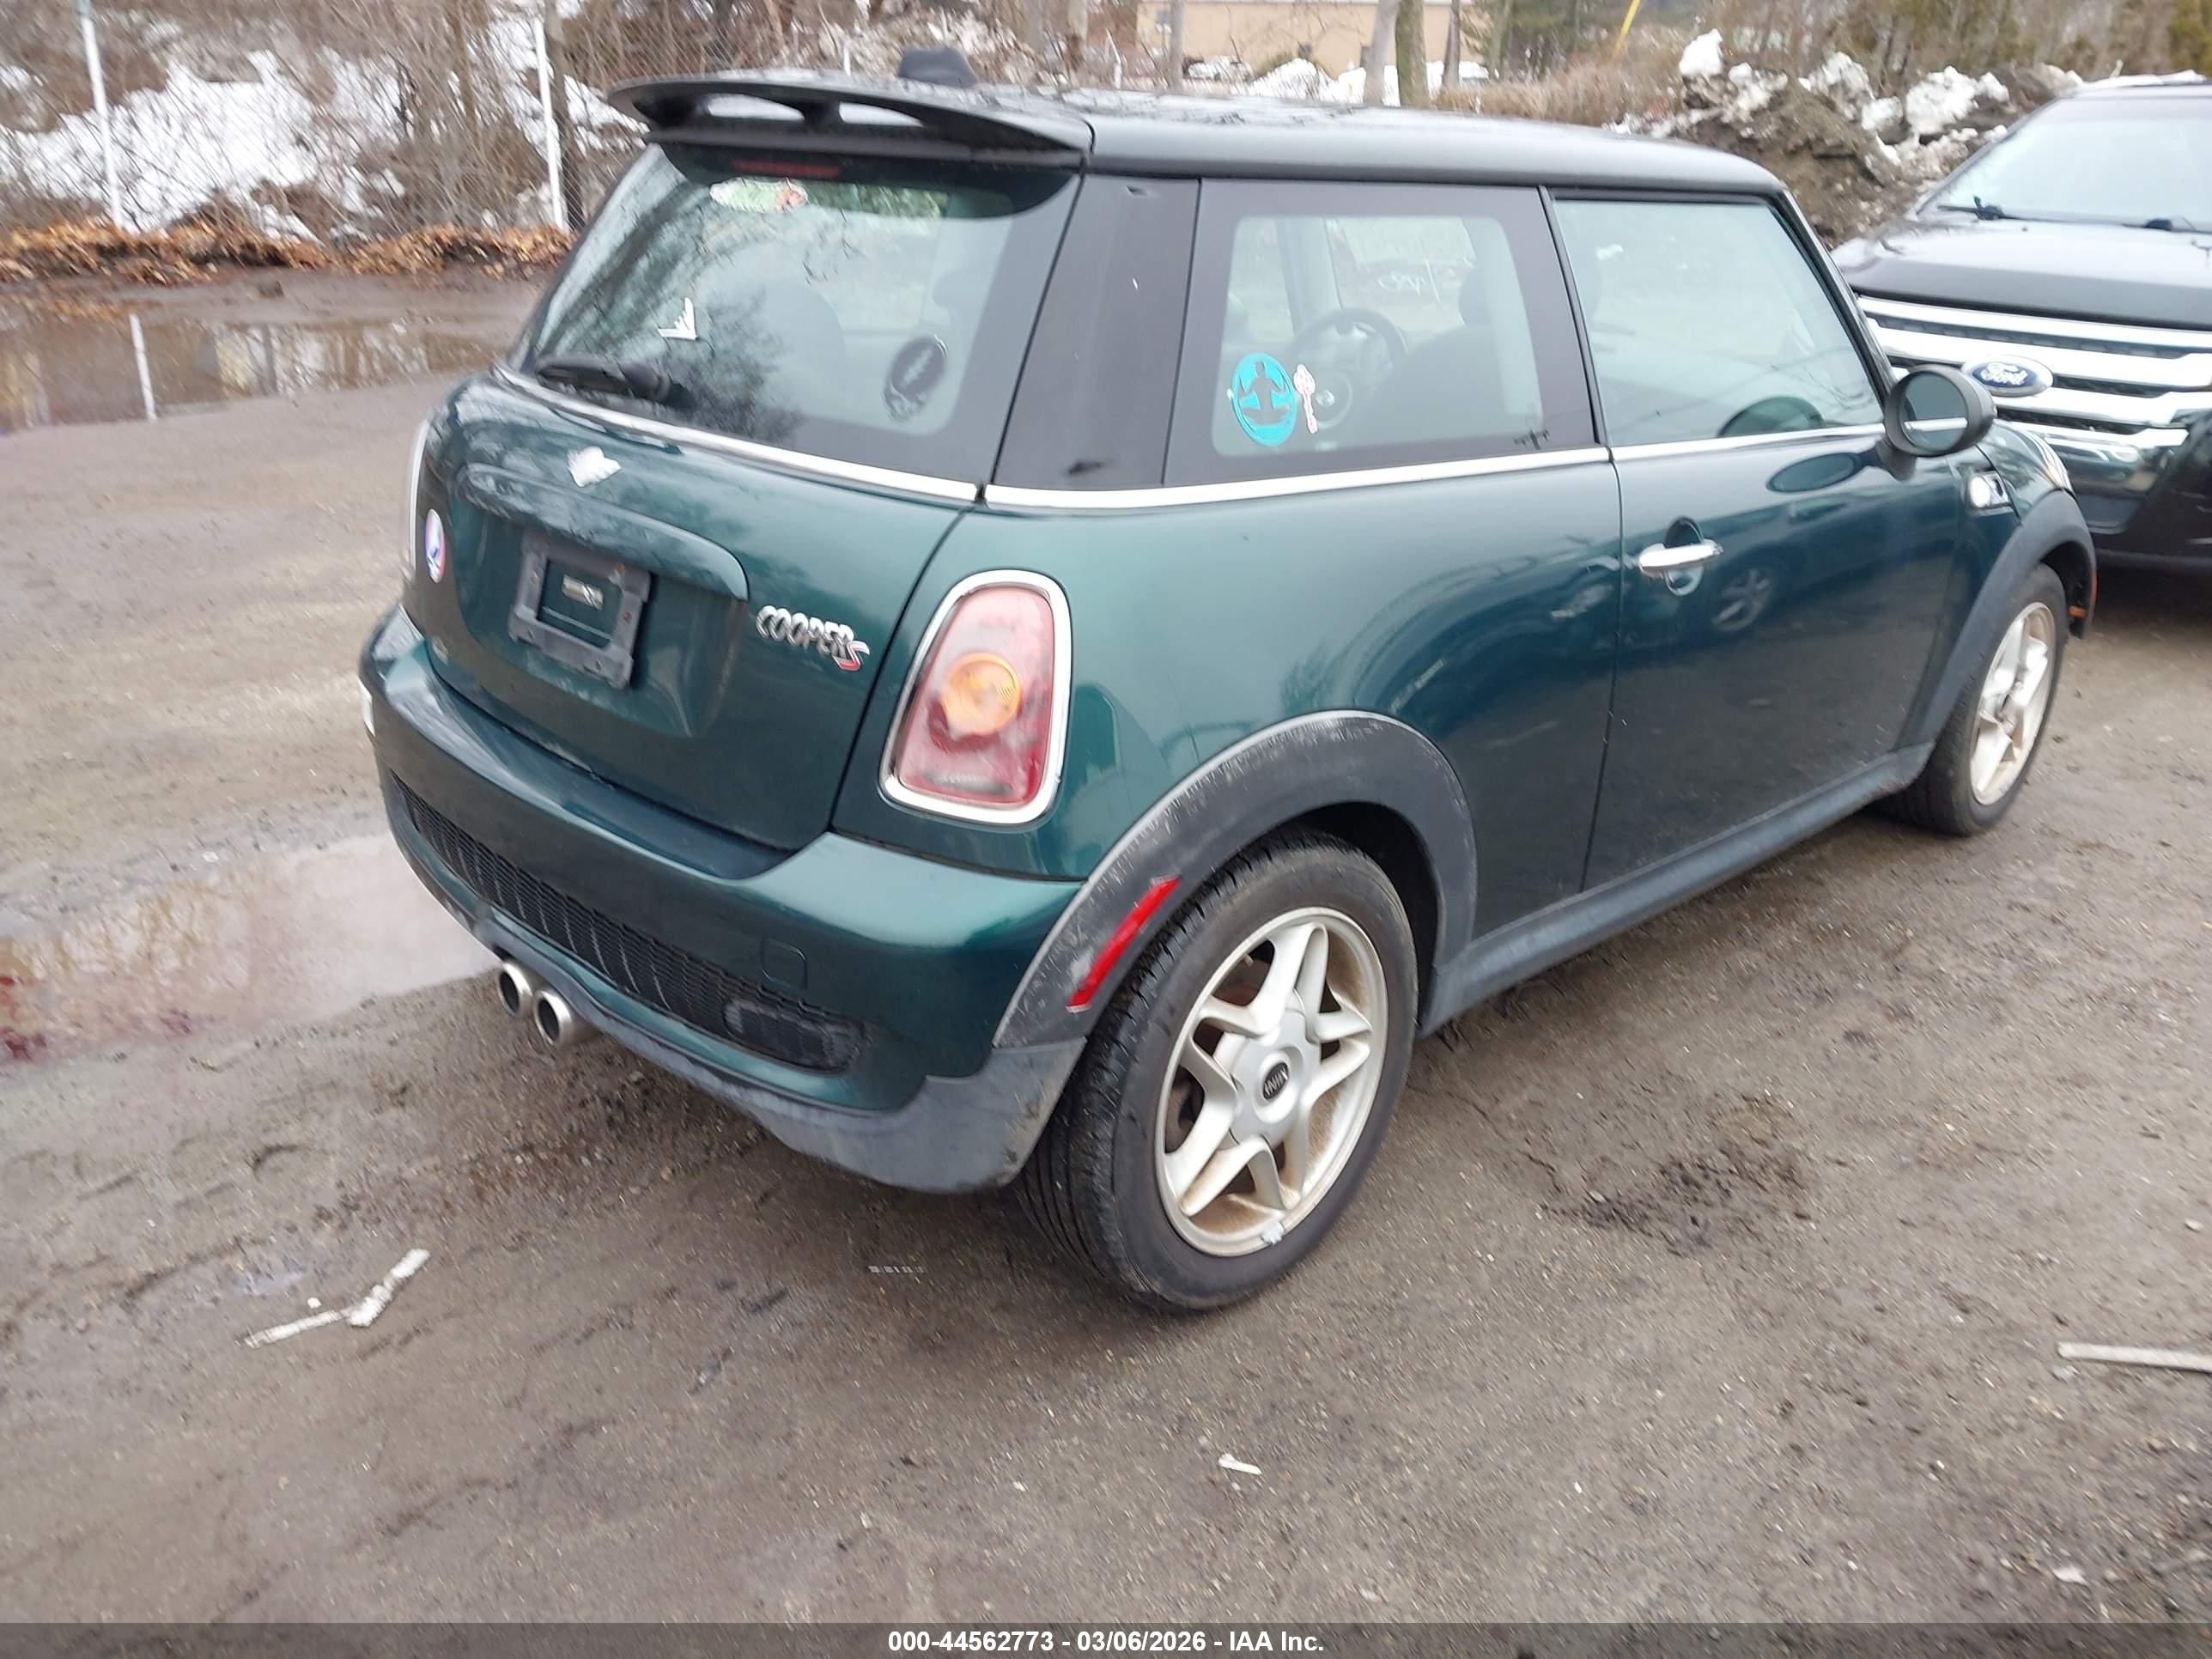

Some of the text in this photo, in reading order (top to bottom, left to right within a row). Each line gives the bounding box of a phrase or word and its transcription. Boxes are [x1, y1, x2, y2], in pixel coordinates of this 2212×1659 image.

[1980, 362, 2029, 386] Ford
[756, 605, 871, 672] COOPER S
